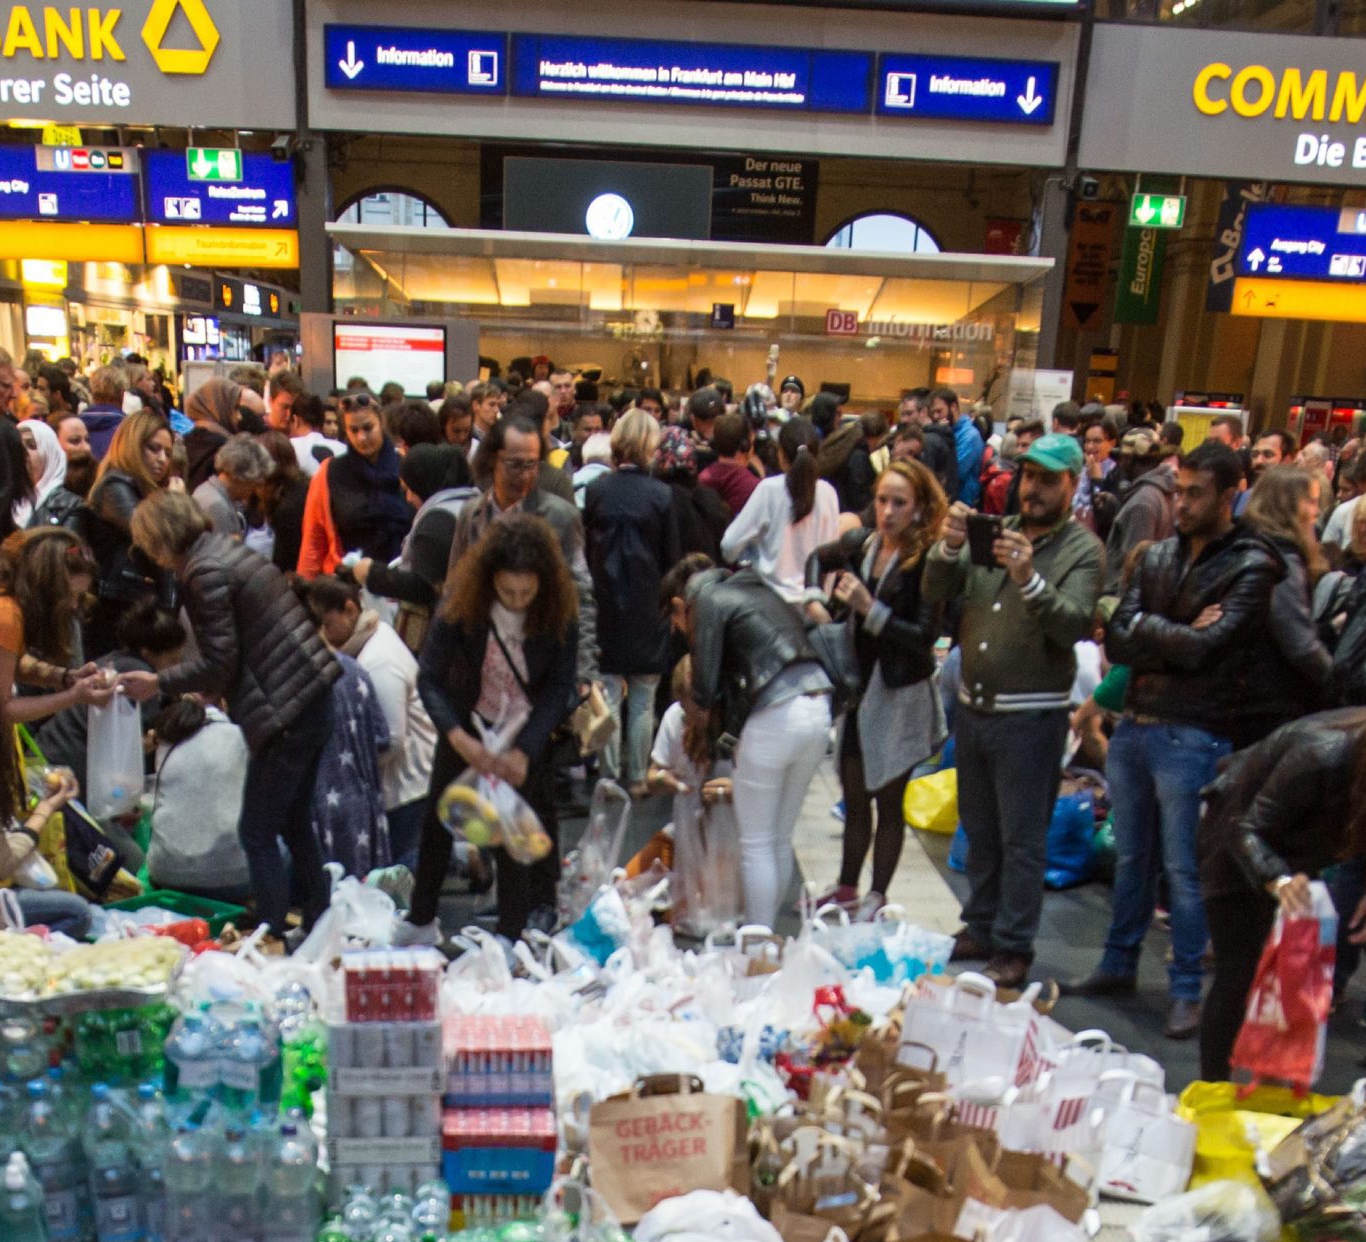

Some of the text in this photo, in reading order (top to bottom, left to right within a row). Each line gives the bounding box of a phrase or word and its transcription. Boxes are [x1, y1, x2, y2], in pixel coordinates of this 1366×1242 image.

[377, 46, 454, 67] Information
[671, 67, 723, 85] Frankfurt
[744, 71, 773, 87] Main
[929, 75, 1006, 97] Information
[54, 73, 131, 106] Seite
[1294, 133, 1344, 167] Die
[745, 158, 802, 173] Der neue
[730, 174, 771, 188] Passat
[828, 312, 993, 342] DB Information
[621, 1135, 708, 1164] TRÄGER
